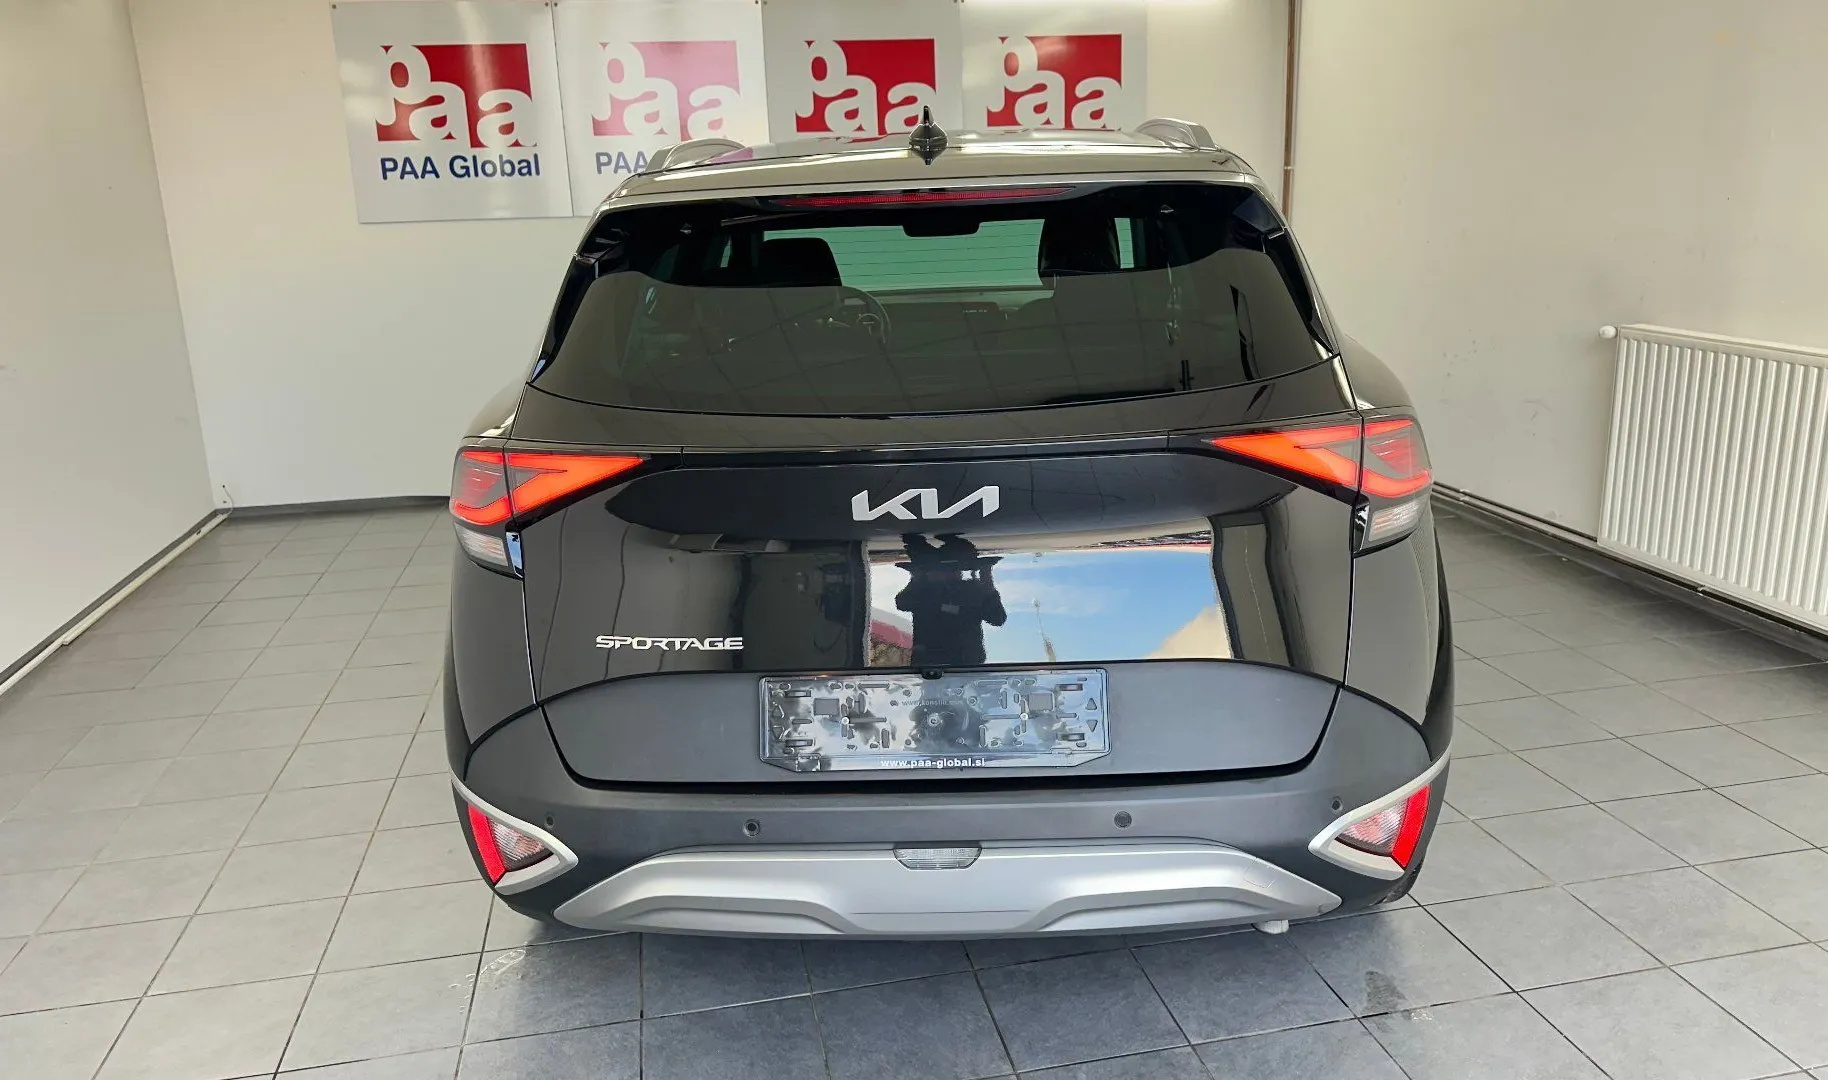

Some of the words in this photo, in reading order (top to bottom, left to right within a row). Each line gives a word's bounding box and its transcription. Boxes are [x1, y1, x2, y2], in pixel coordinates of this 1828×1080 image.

[380, 156, 440, 180] PAA
[449, 153, 541, 178] Global
[594, 151, 649, 174] PAA
[595, 635, 744, 651] SPORTAGE
[880, 757, 986, 769] www.paa-global.si
